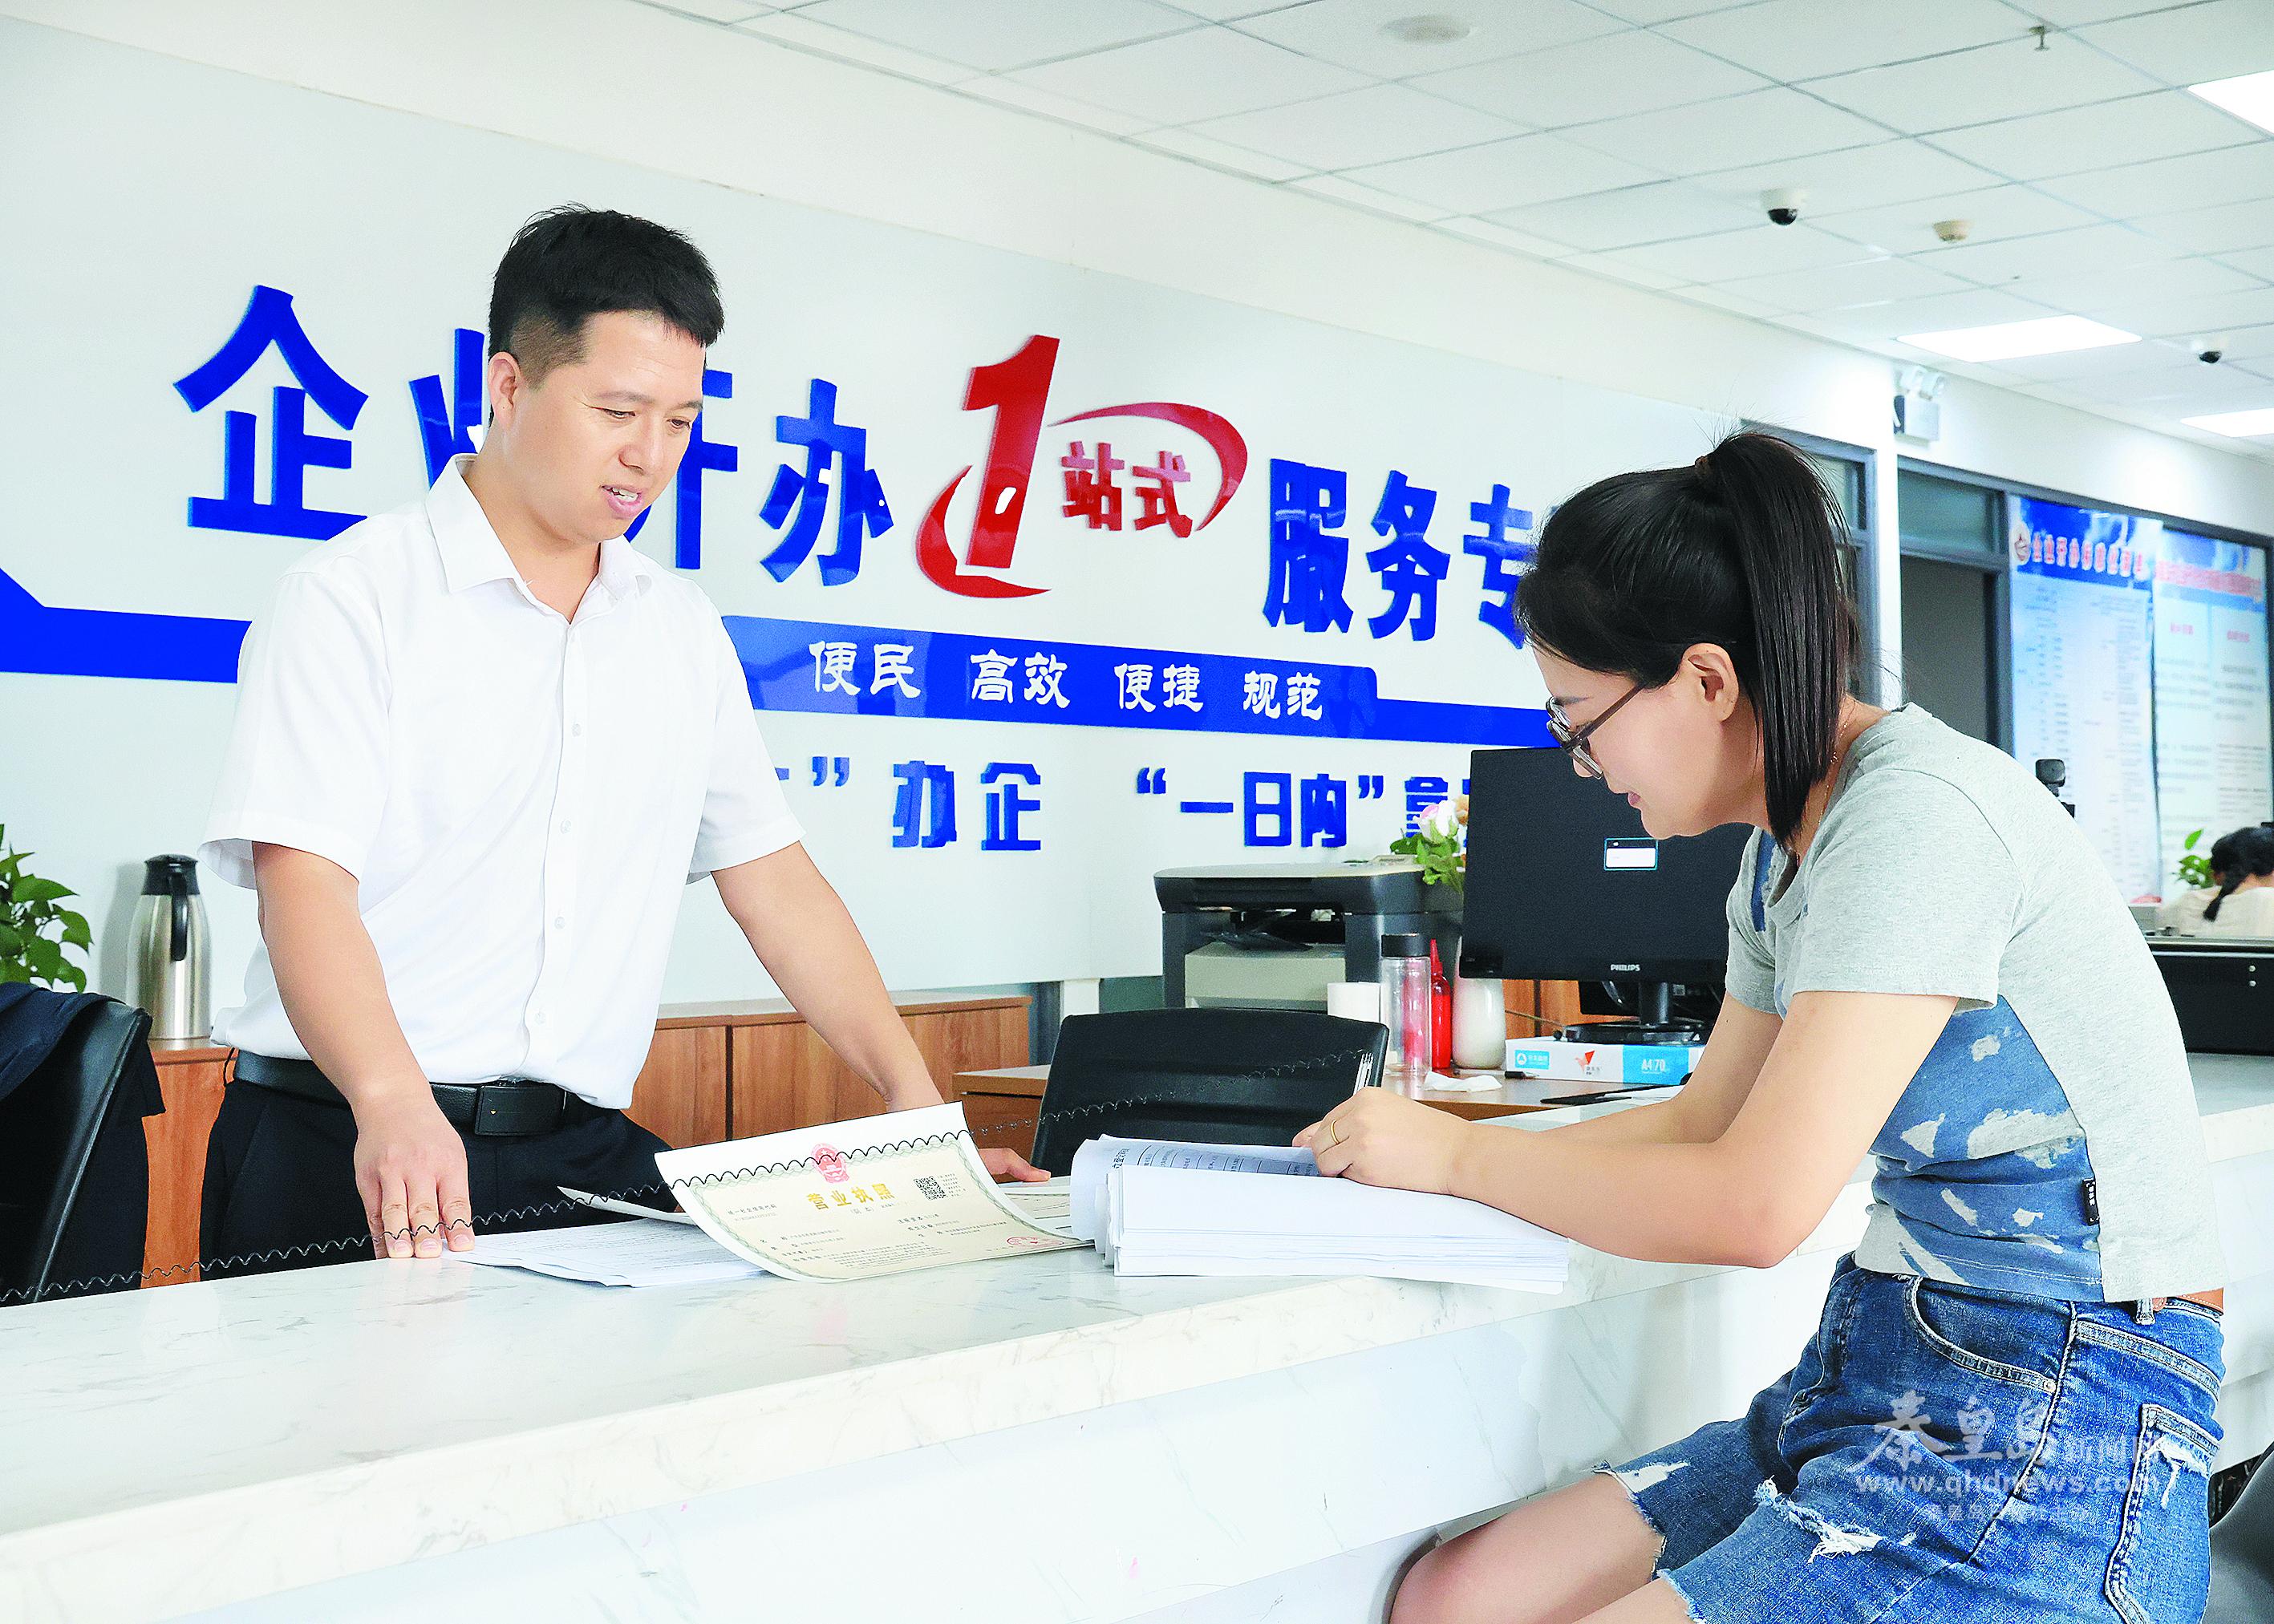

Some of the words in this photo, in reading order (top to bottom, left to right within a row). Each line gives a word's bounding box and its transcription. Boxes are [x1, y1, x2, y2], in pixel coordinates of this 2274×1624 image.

[809, 640, 922, 699] 便民
[971, 653, 1072, 709] 高效
[1113, 662, 1204, 713] 便捷
[1242, 670, 1323, 721] 规范
[1610, 964, 1640, 972] PHILIPS
[808, 1183, 895, 1209] 营业执照
